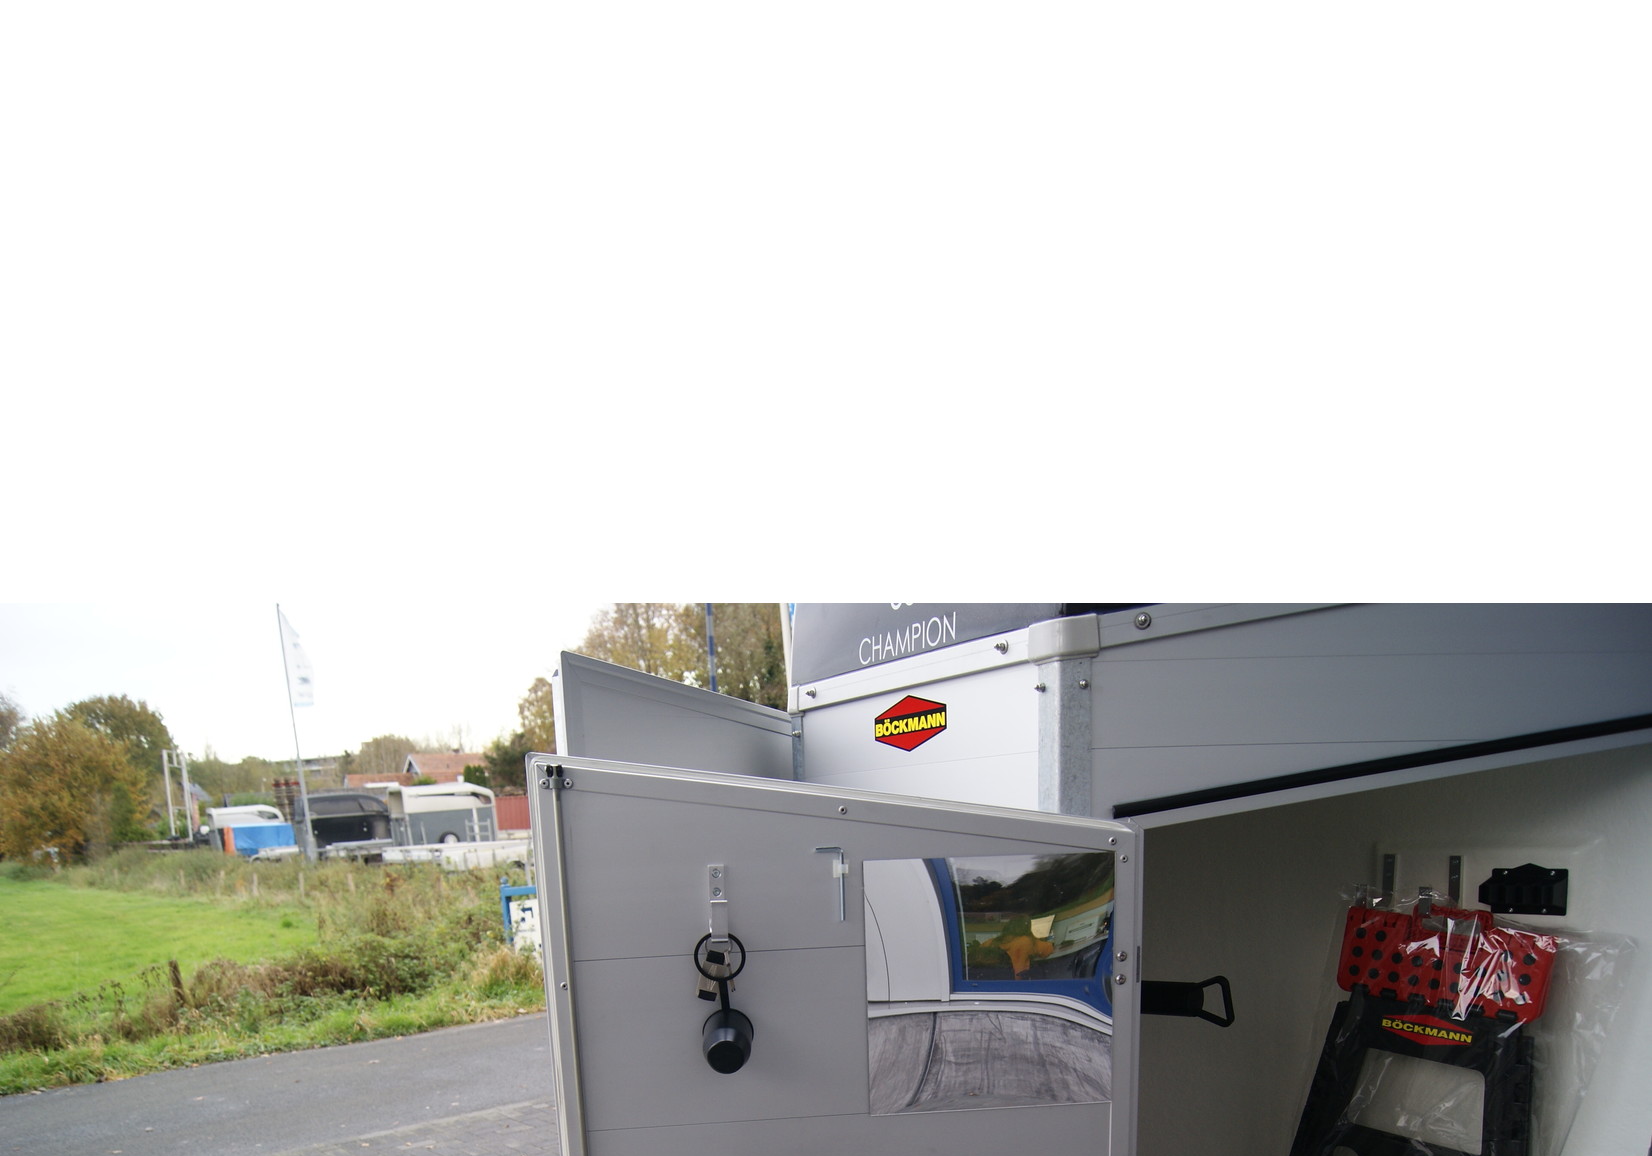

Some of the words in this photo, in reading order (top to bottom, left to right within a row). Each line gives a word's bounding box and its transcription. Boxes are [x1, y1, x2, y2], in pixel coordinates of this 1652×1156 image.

[859, 611, 956, 664] CHAMPION
[875, 711, 946, 737] BÖCKMANN
[1382, 1019, 1472, 1043] BÖCKMANN
